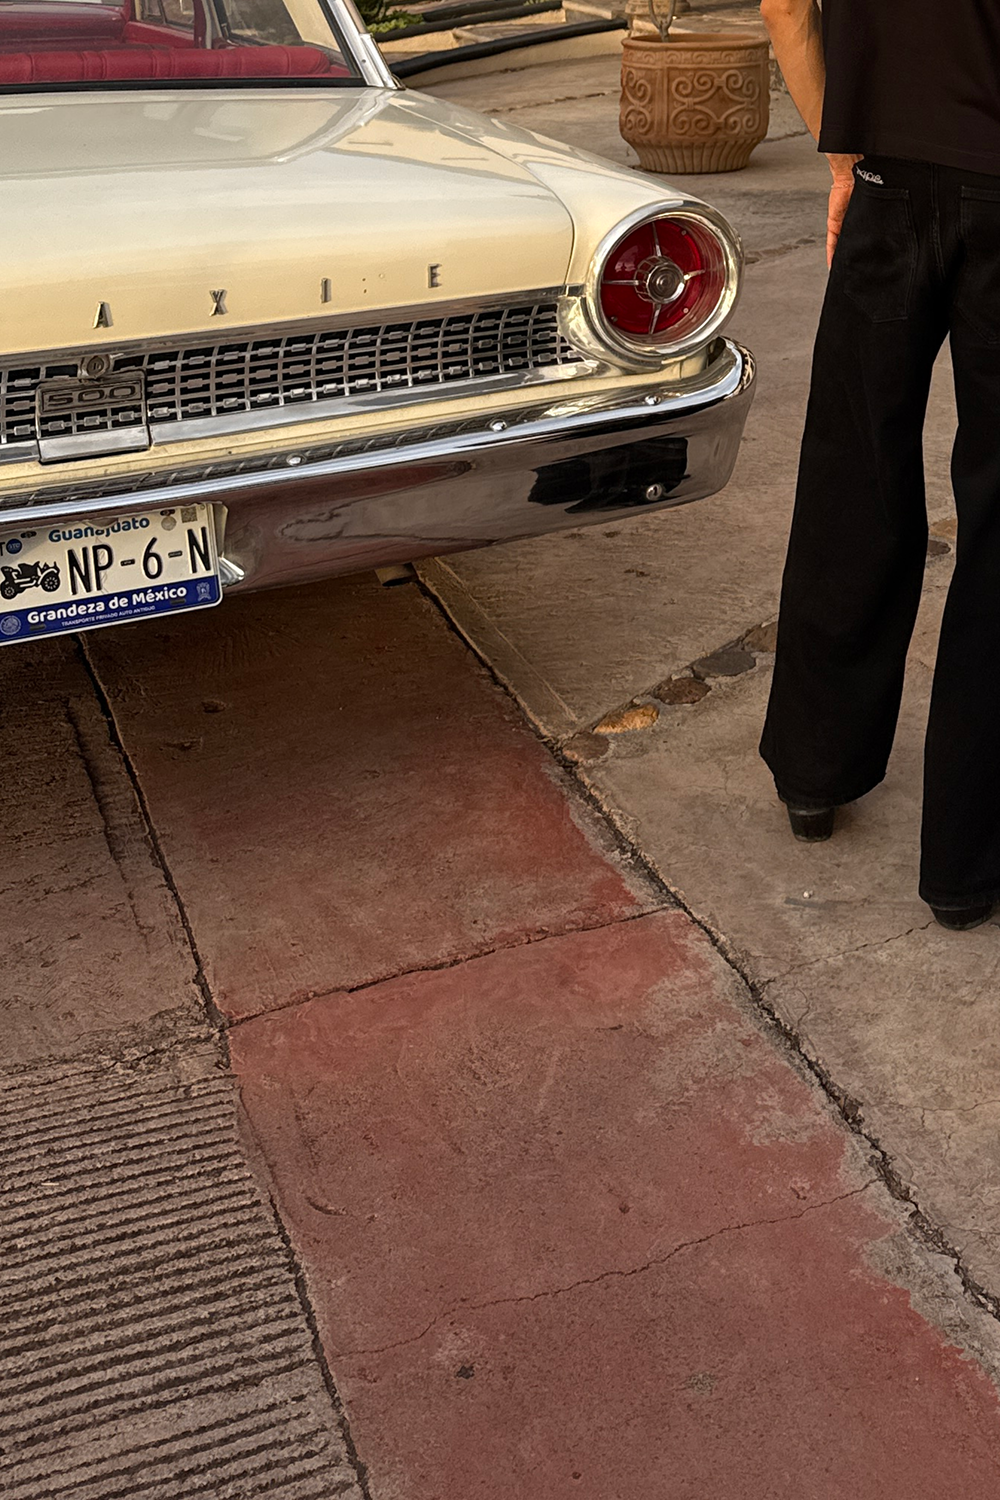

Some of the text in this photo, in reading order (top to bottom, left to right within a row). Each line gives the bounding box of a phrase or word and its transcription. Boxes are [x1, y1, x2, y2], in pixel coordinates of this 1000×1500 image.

[48, 385, 136, 407] 500
[27, 587, 187, 624] Grandeza de México
[119, 609, 133, 617] AUTO
